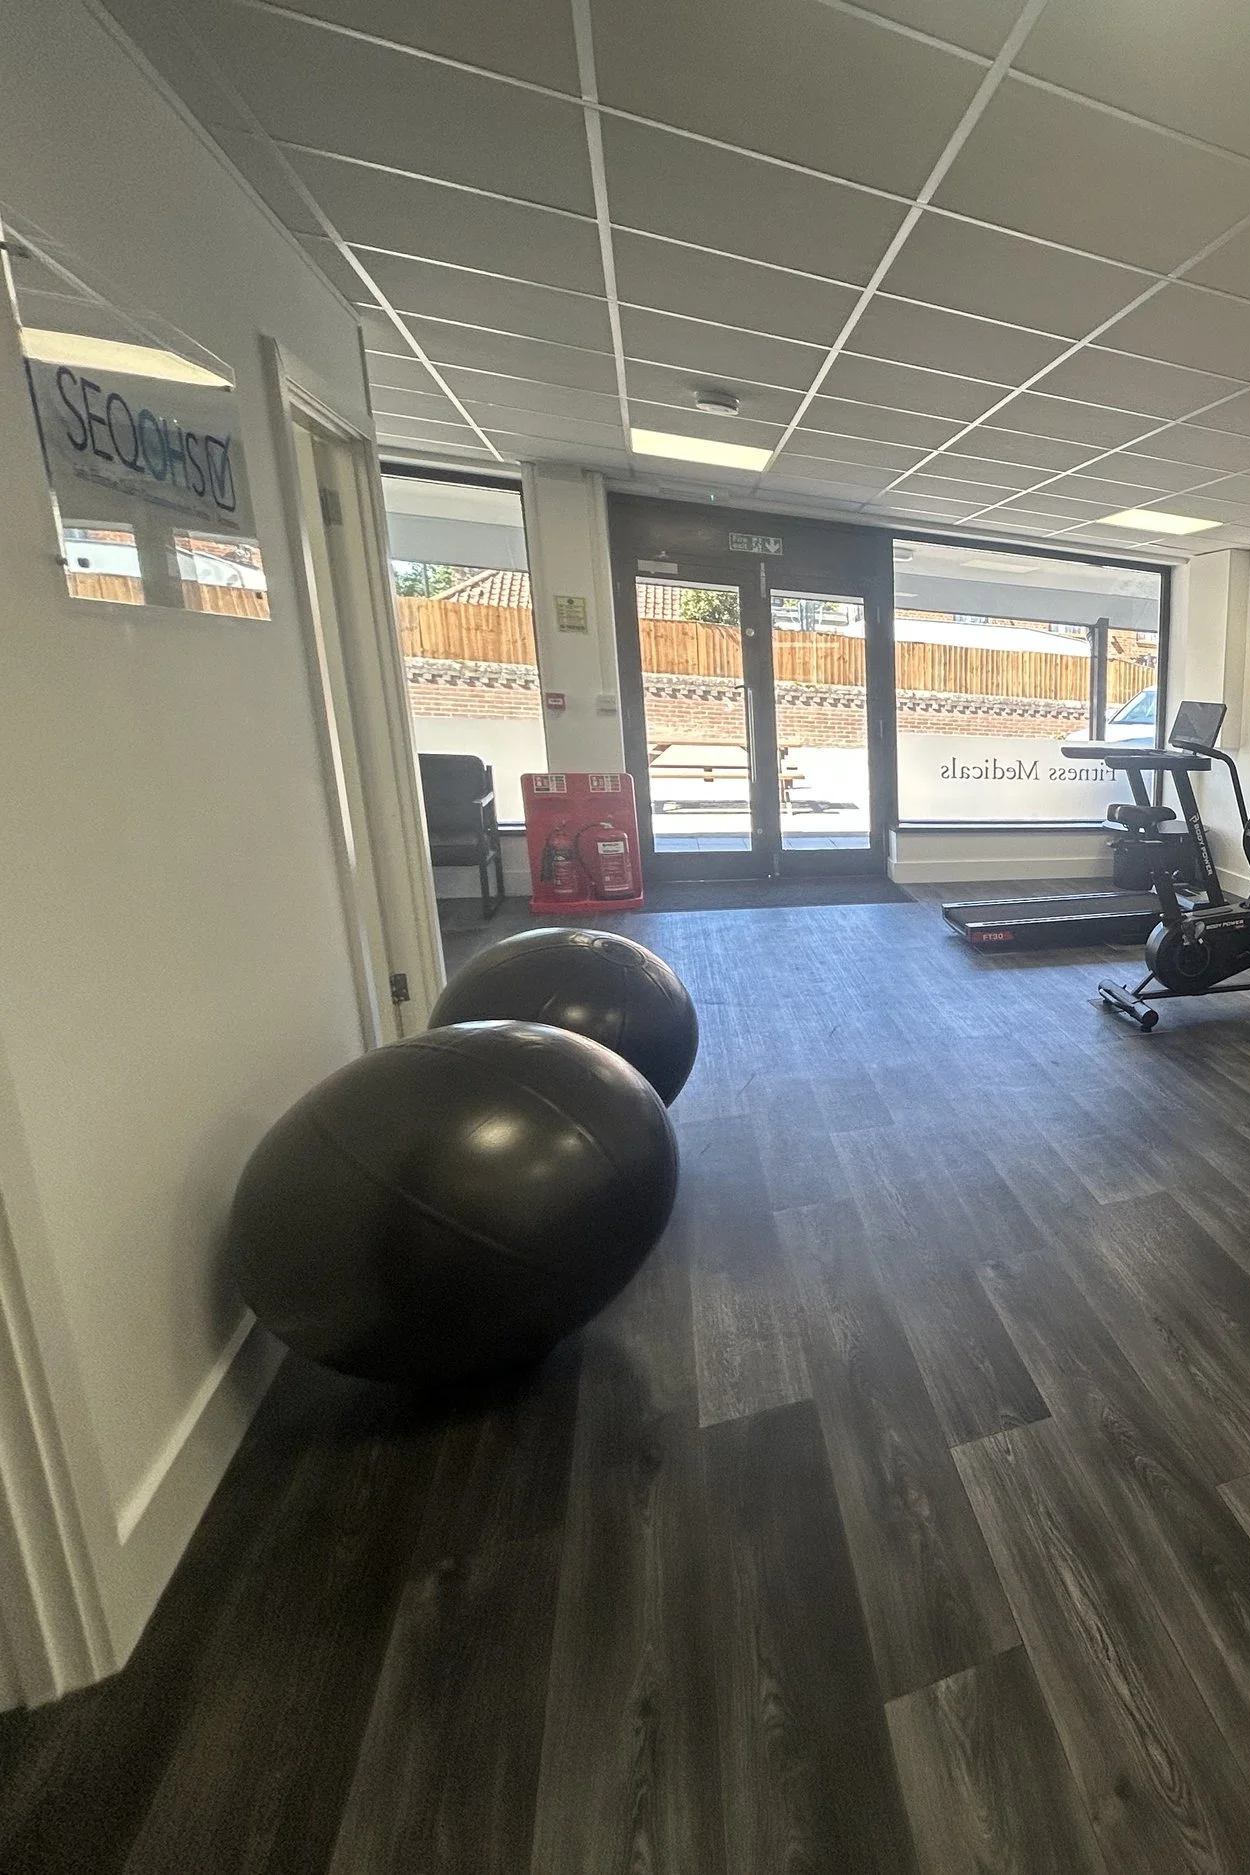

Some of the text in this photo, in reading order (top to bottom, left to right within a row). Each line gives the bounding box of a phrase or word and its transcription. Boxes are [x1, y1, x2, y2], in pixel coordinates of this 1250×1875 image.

[56, 365, 205, 497] SEQOHS
[1193, 823, 1213, 876] BODY POWER
[982, 932, 1004, 941] FT30
